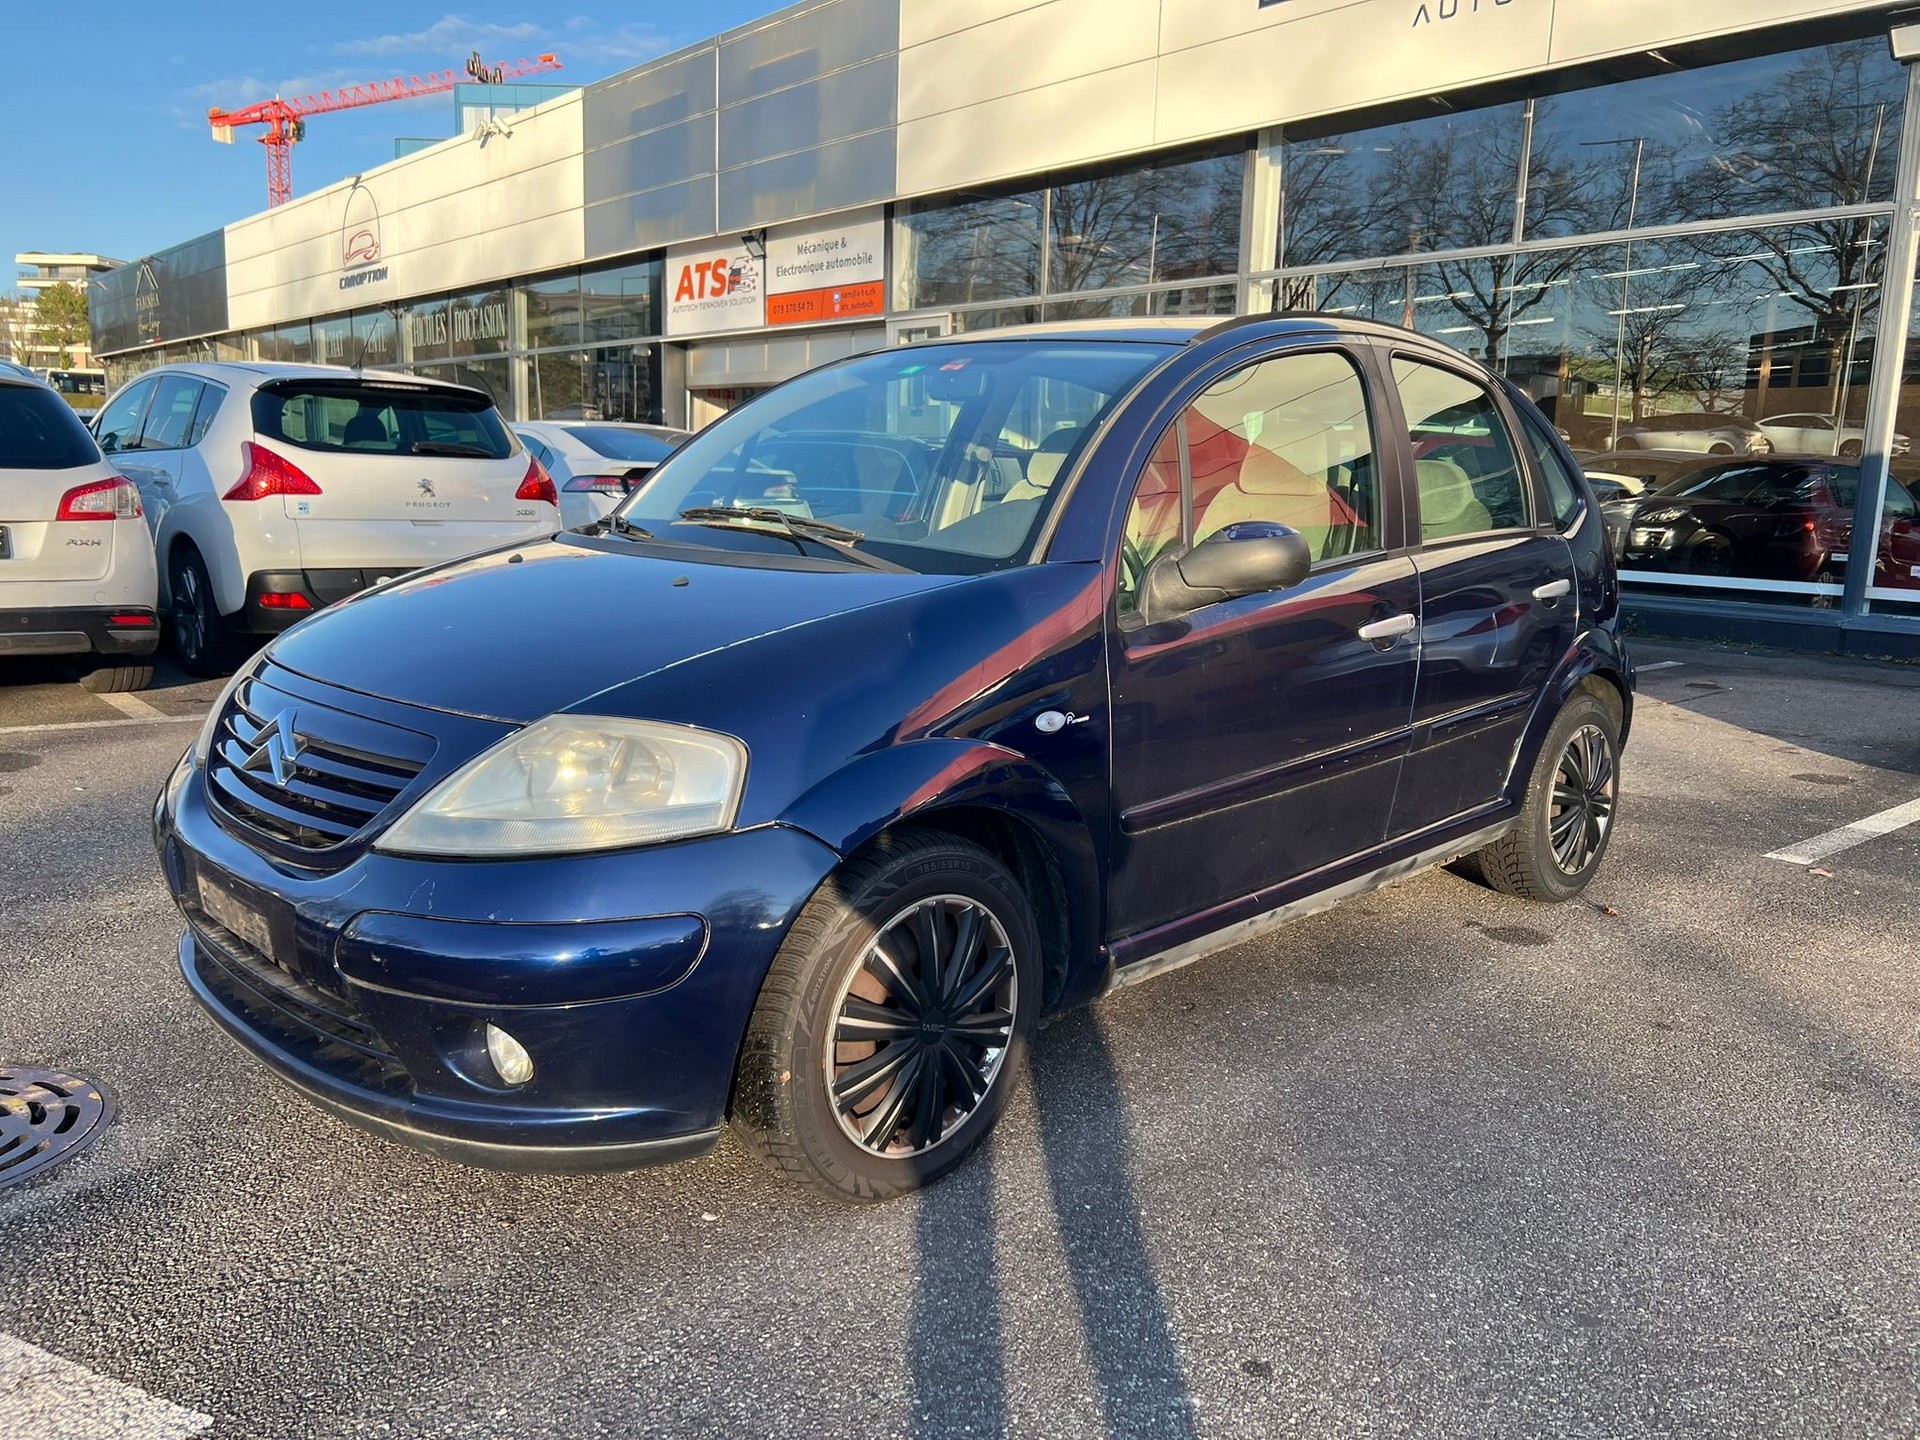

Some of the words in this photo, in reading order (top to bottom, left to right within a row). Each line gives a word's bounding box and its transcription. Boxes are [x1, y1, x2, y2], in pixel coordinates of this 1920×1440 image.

[797, 240, 840, 256] Mécanique
[840, 236, 848, 249] &
[776, 260, 824, 277] Electronique
[825, 252, 873, 270] automobile
[339, 266, 389, 290] CAROPTION
[675, 258, 728, 303] ATS
[729, 296, 757, 308] SOLUTION
[454, 303, 506, 342] D'OCCASION
[811, 957, 833, 1003] ROTATION
